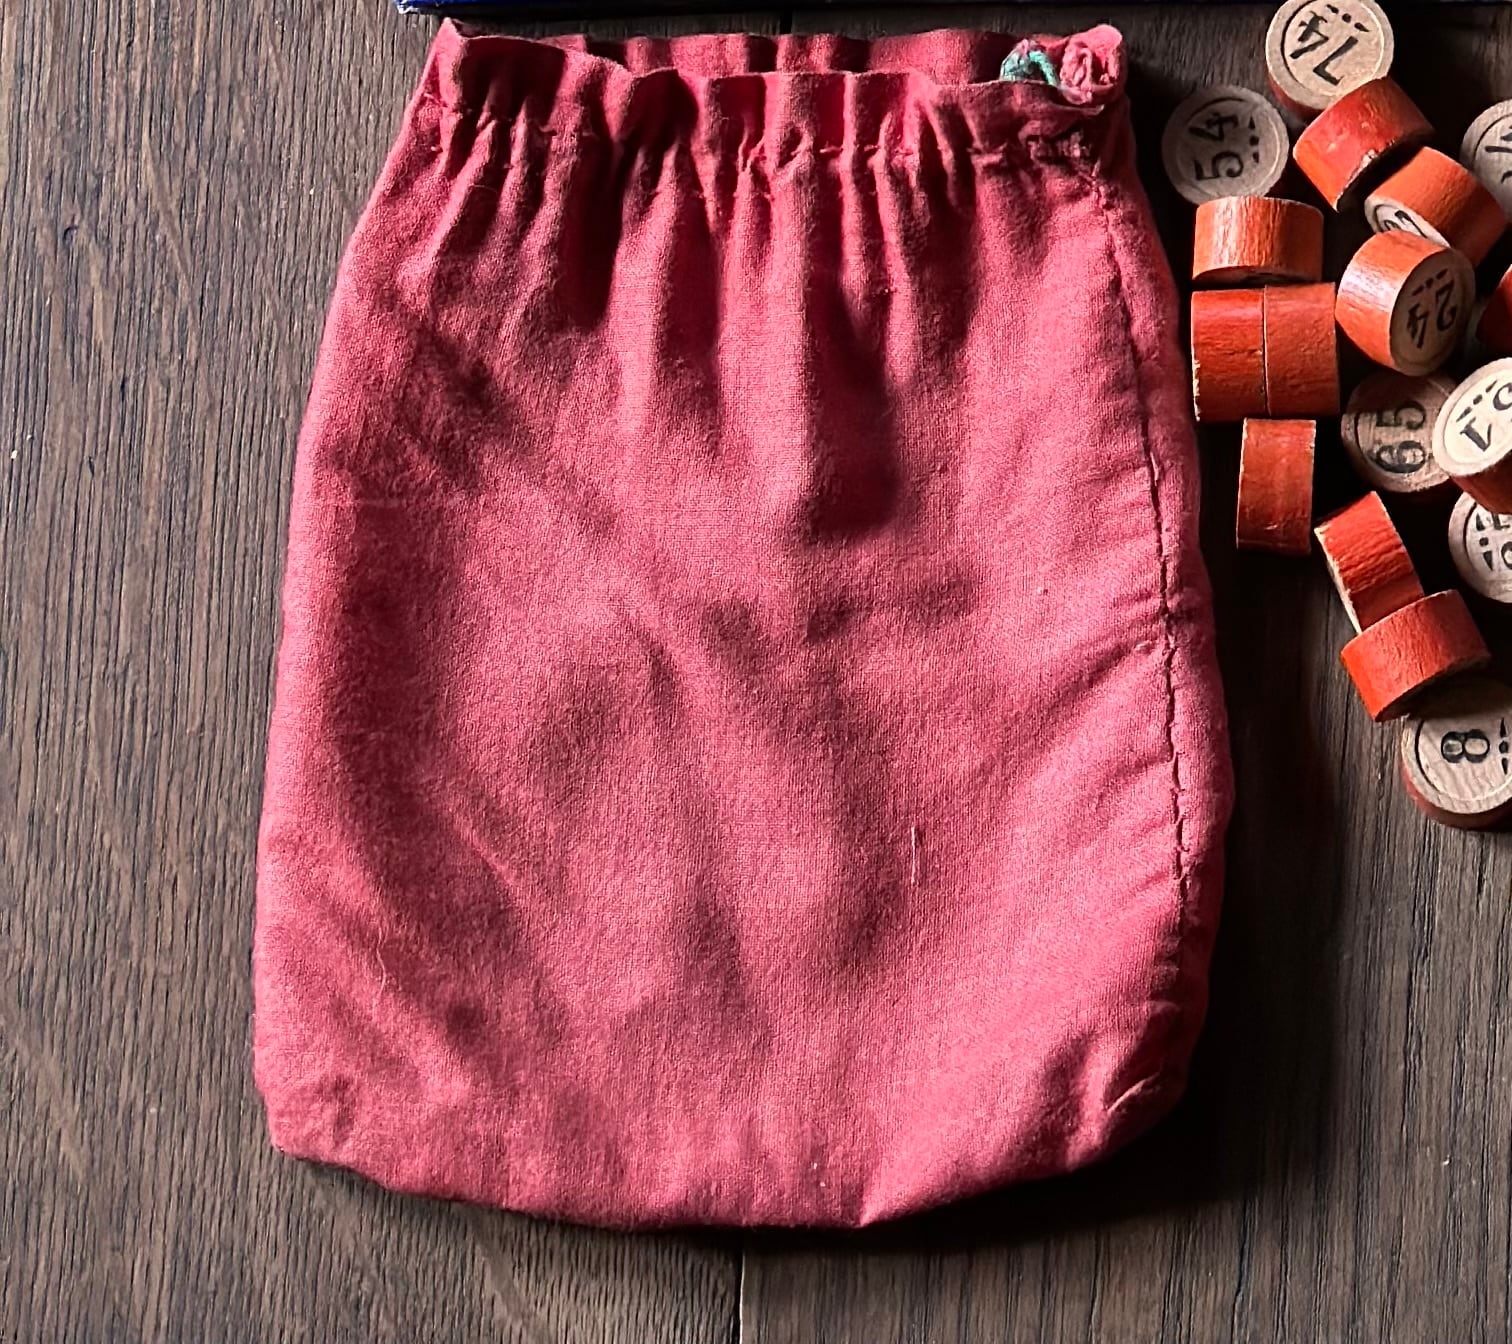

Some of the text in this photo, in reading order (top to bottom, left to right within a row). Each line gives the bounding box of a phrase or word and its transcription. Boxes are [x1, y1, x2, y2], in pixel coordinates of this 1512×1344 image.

[1290, 13, 1358, 86] 74
[1189, 112, 1243, 182] 54
[1407, 280, 1457, 349] 24
[1440, 729, 1491, 763] 8
